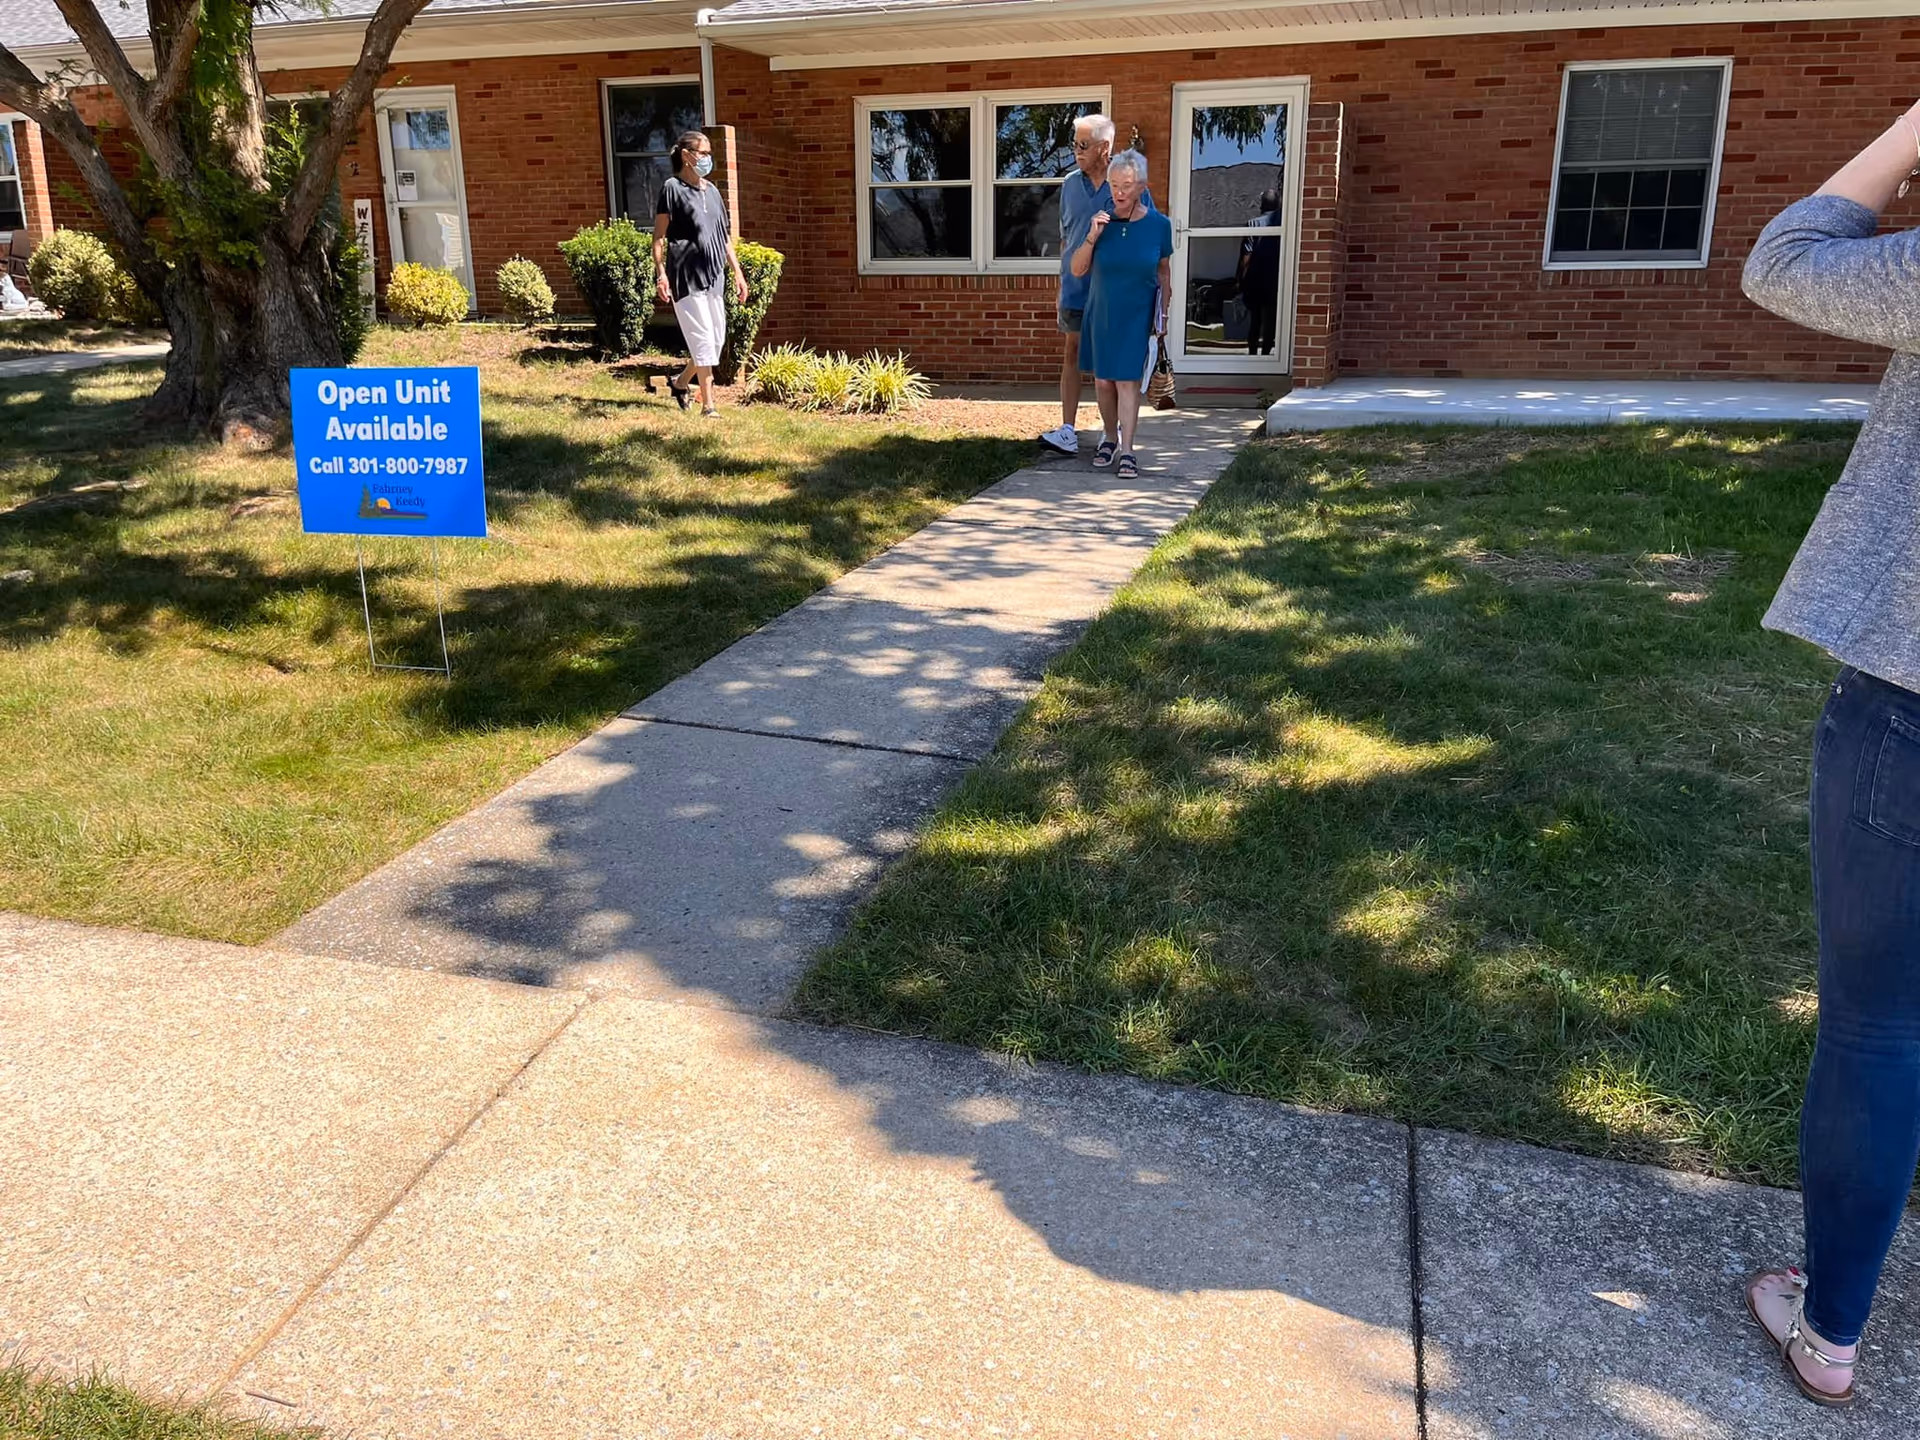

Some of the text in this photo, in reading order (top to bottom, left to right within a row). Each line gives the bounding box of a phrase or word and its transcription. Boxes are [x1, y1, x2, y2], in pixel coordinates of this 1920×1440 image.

[317, 378, 451, 411] Open Unit
[325, 415, 448, 441] Available
[309, 456, 468, 475] Call 301-800-7987
[372, 482, 414, 496] Fahrney
[395, 496, 426, 508] Keedy
